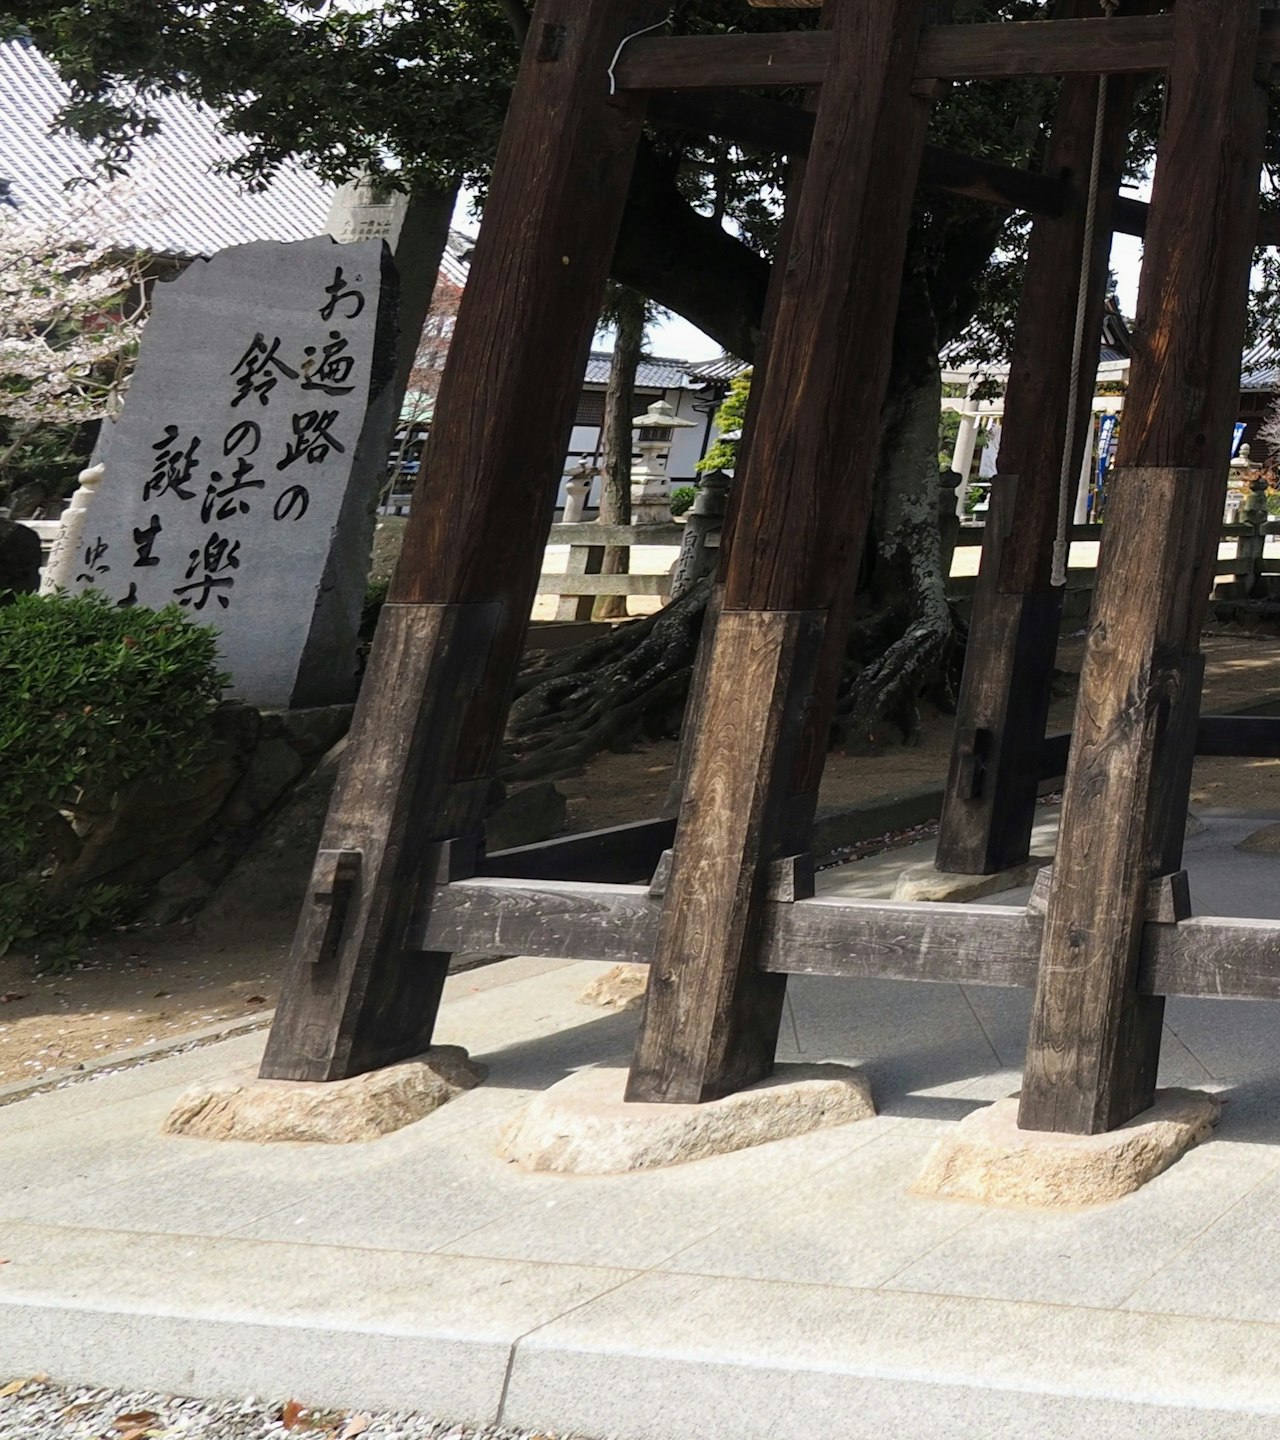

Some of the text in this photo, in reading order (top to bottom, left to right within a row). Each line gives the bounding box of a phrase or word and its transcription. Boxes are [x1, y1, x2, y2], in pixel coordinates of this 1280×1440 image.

[172, 332, 300, 610] 鈴の法楽
[273, 267, 366, 522] お遍路の
